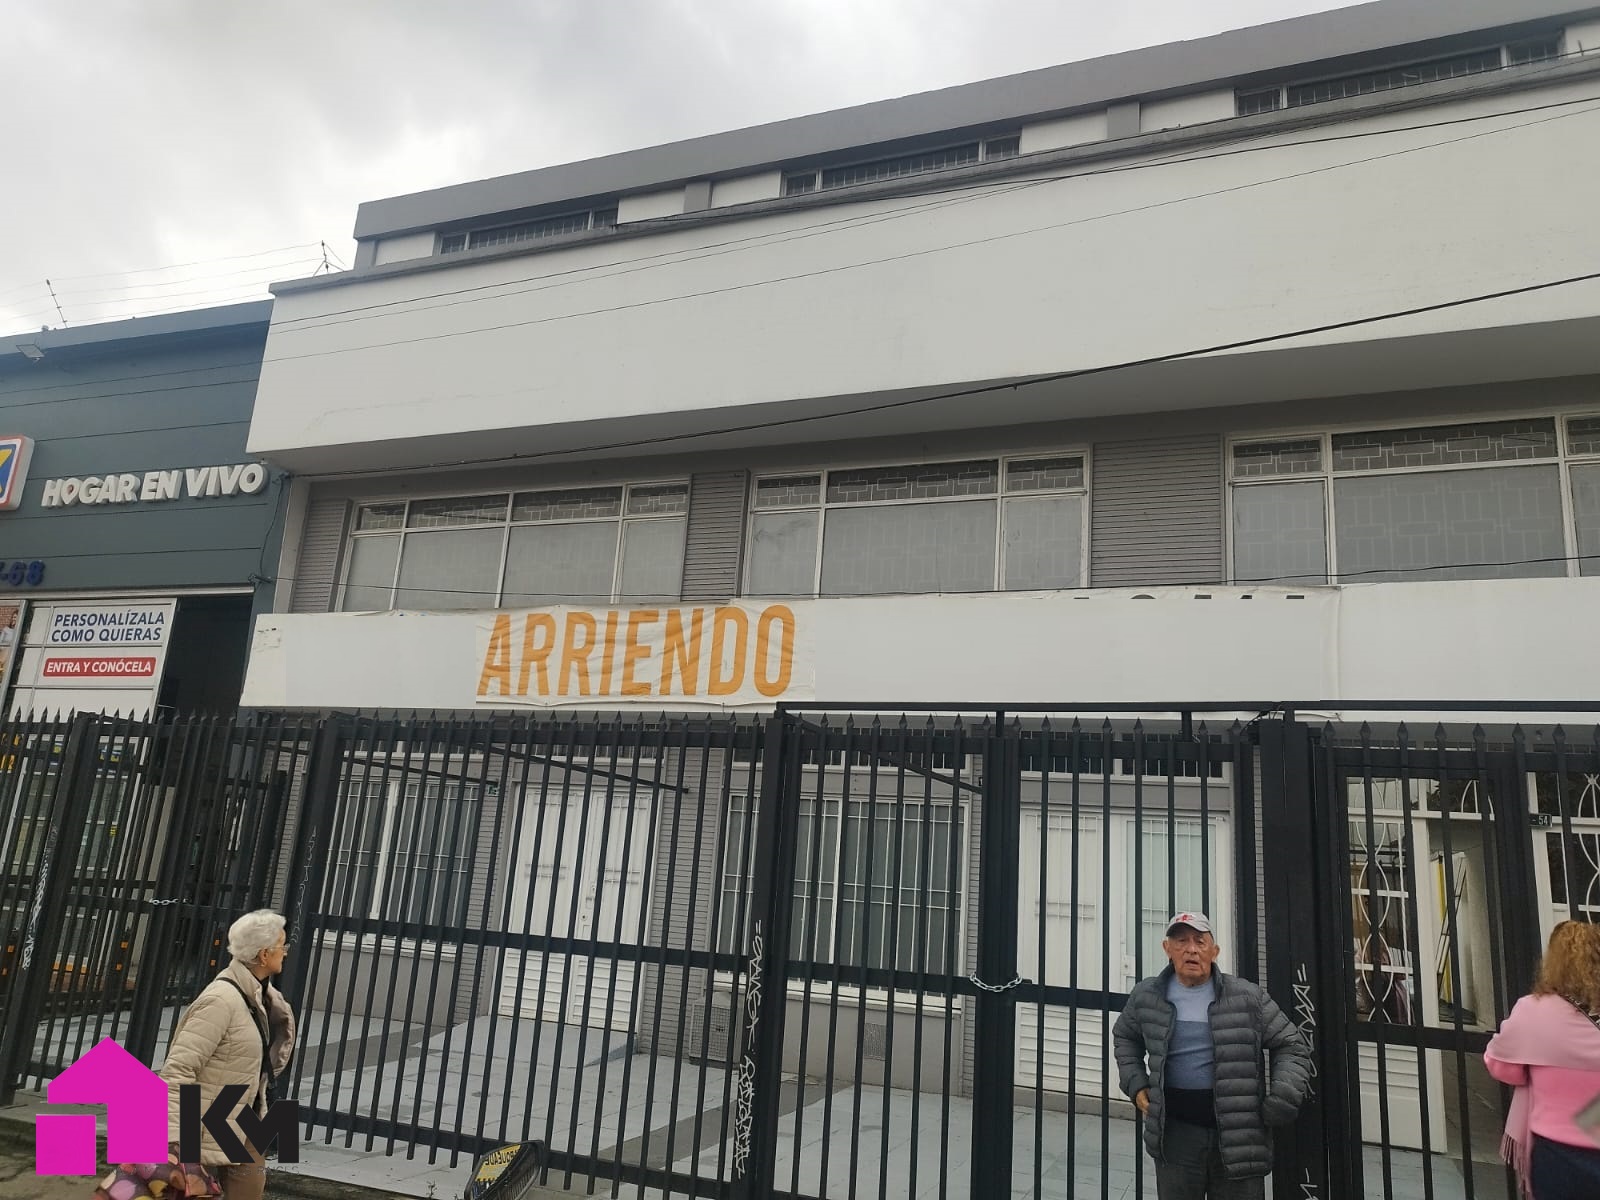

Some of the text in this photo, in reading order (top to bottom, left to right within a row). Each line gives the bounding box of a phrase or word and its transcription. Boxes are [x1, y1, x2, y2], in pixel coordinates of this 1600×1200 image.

[41, 464, 268, 507] HOGAR EN VIVO
[0, 560, 46, 586] -68
[54, 609, 165, 627] PERSONALÍZALA
[51, 627, 162, 642] COMO QUIERAS
[476, 604, 796, 697] ARRIENDO
[46, 658, 152, 673] ENTRA Y CONÓCELA
